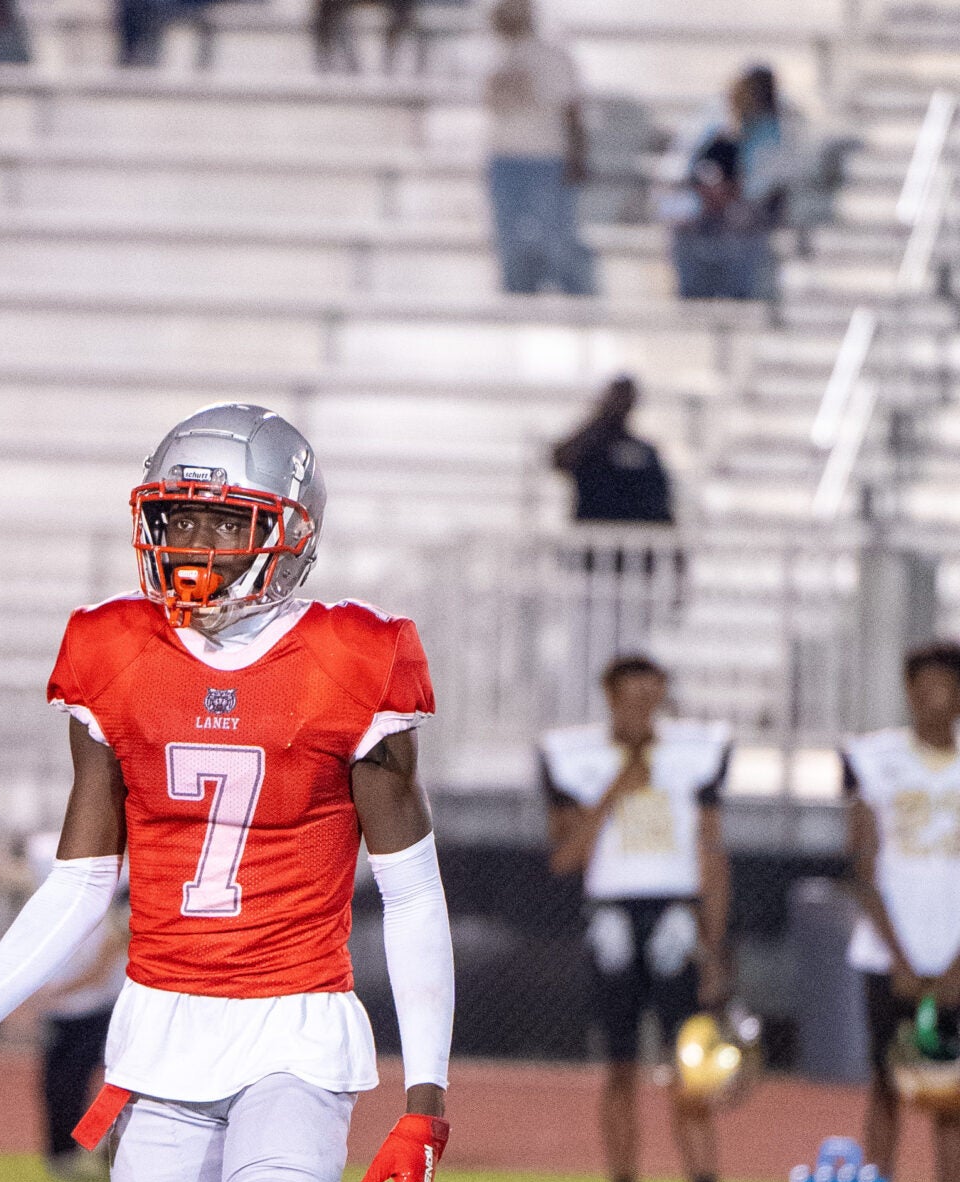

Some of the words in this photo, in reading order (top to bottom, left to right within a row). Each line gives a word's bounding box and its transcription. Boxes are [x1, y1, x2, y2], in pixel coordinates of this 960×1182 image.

[184, 471, 209, 479] schutt
[195, 716, 241, 730] LANEY
[165, 741, 266, 917] 7
